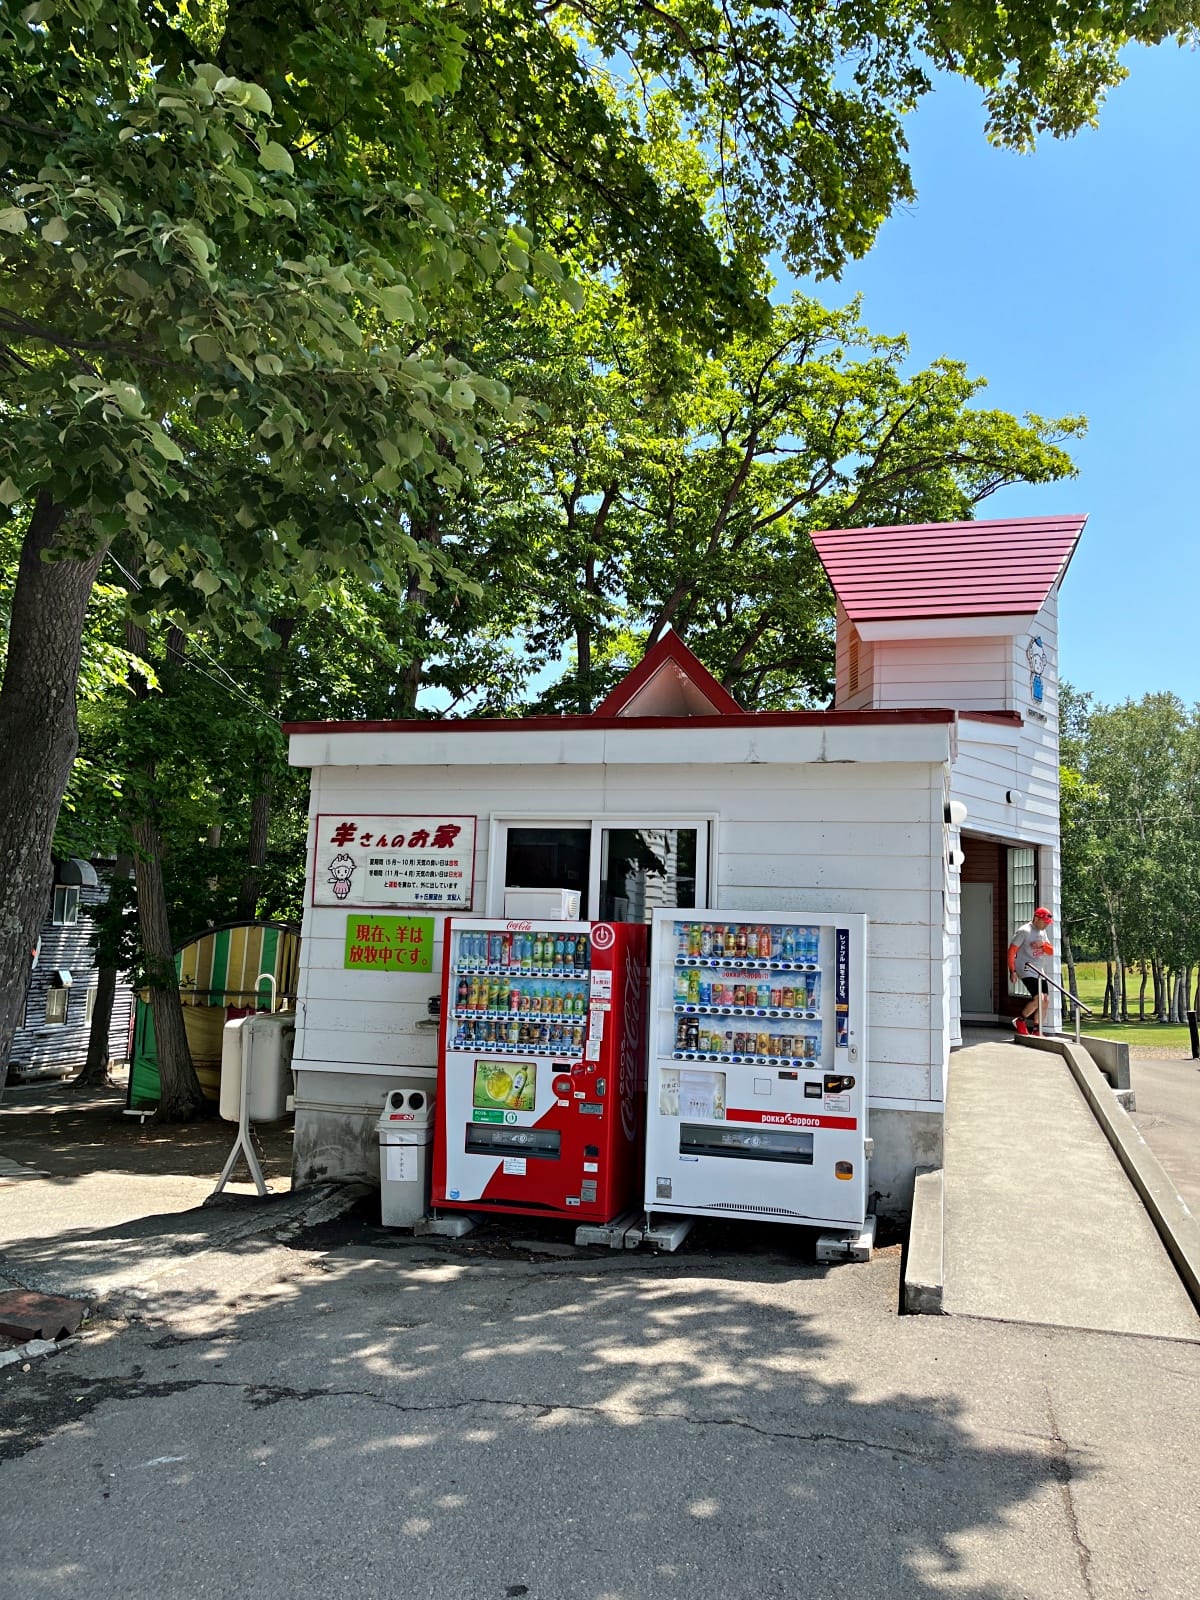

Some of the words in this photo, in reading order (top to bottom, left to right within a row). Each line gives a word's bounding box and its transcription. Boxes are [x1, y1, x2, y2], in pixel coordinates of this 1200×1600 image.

[330, 822, 462, 849] 羊さんのお家
[355, 924, 424, 943] 現在、羊は
[506, 920, 532, 930] Coca-Cola
[350, 945, 428, 965] 放牧中です。
